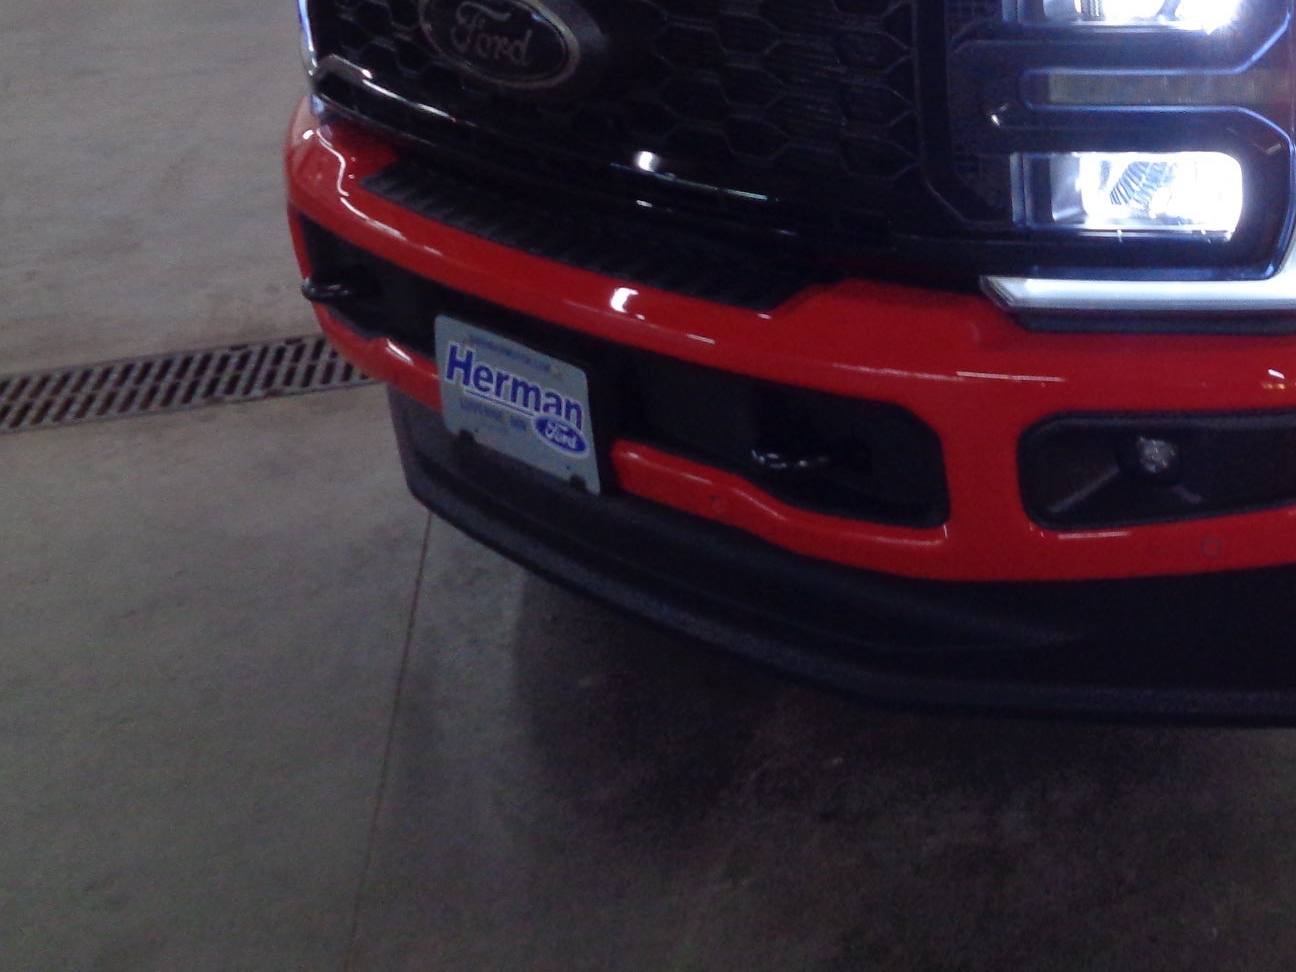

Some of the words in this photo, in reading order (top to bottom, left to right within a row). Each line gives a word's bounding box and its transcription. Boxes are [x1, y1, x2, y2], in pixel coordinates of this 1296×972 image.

[450, 0, 533, 67] Ford
[446, 344, 583, 430] Herman
[544, 419, 578, 450] Ford
